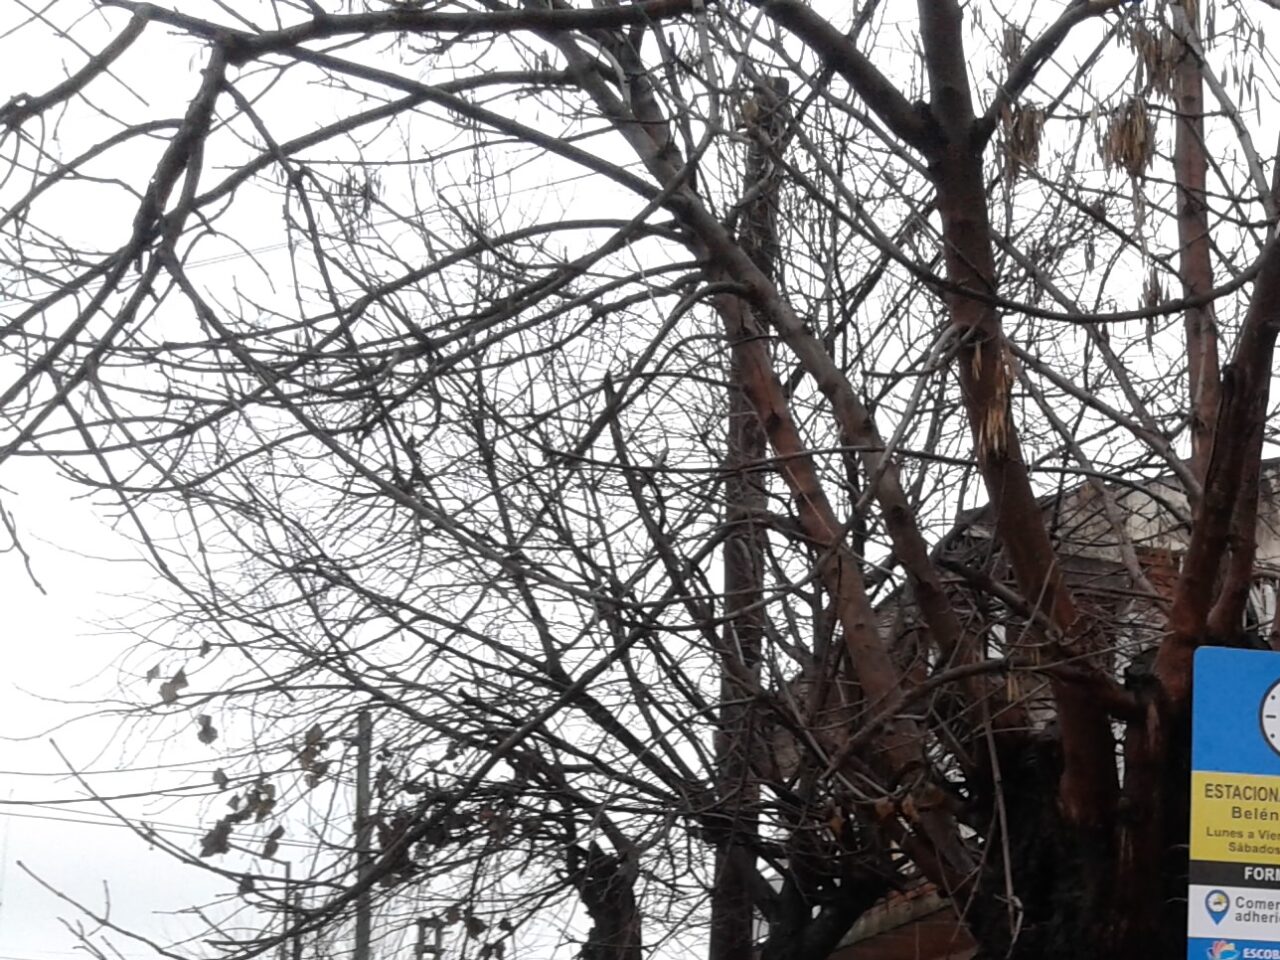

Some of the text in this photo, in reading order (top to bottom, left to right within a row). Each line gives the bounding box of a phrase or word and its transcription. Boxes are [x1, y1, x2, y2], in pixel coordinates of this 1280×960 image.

[1231, 806, 1279, 821] Belén
[1206, 826, 1244, 839] Lunes
[1247, 831, 1255, 839] a
[1228, 842, 1280, 855] Sábados
